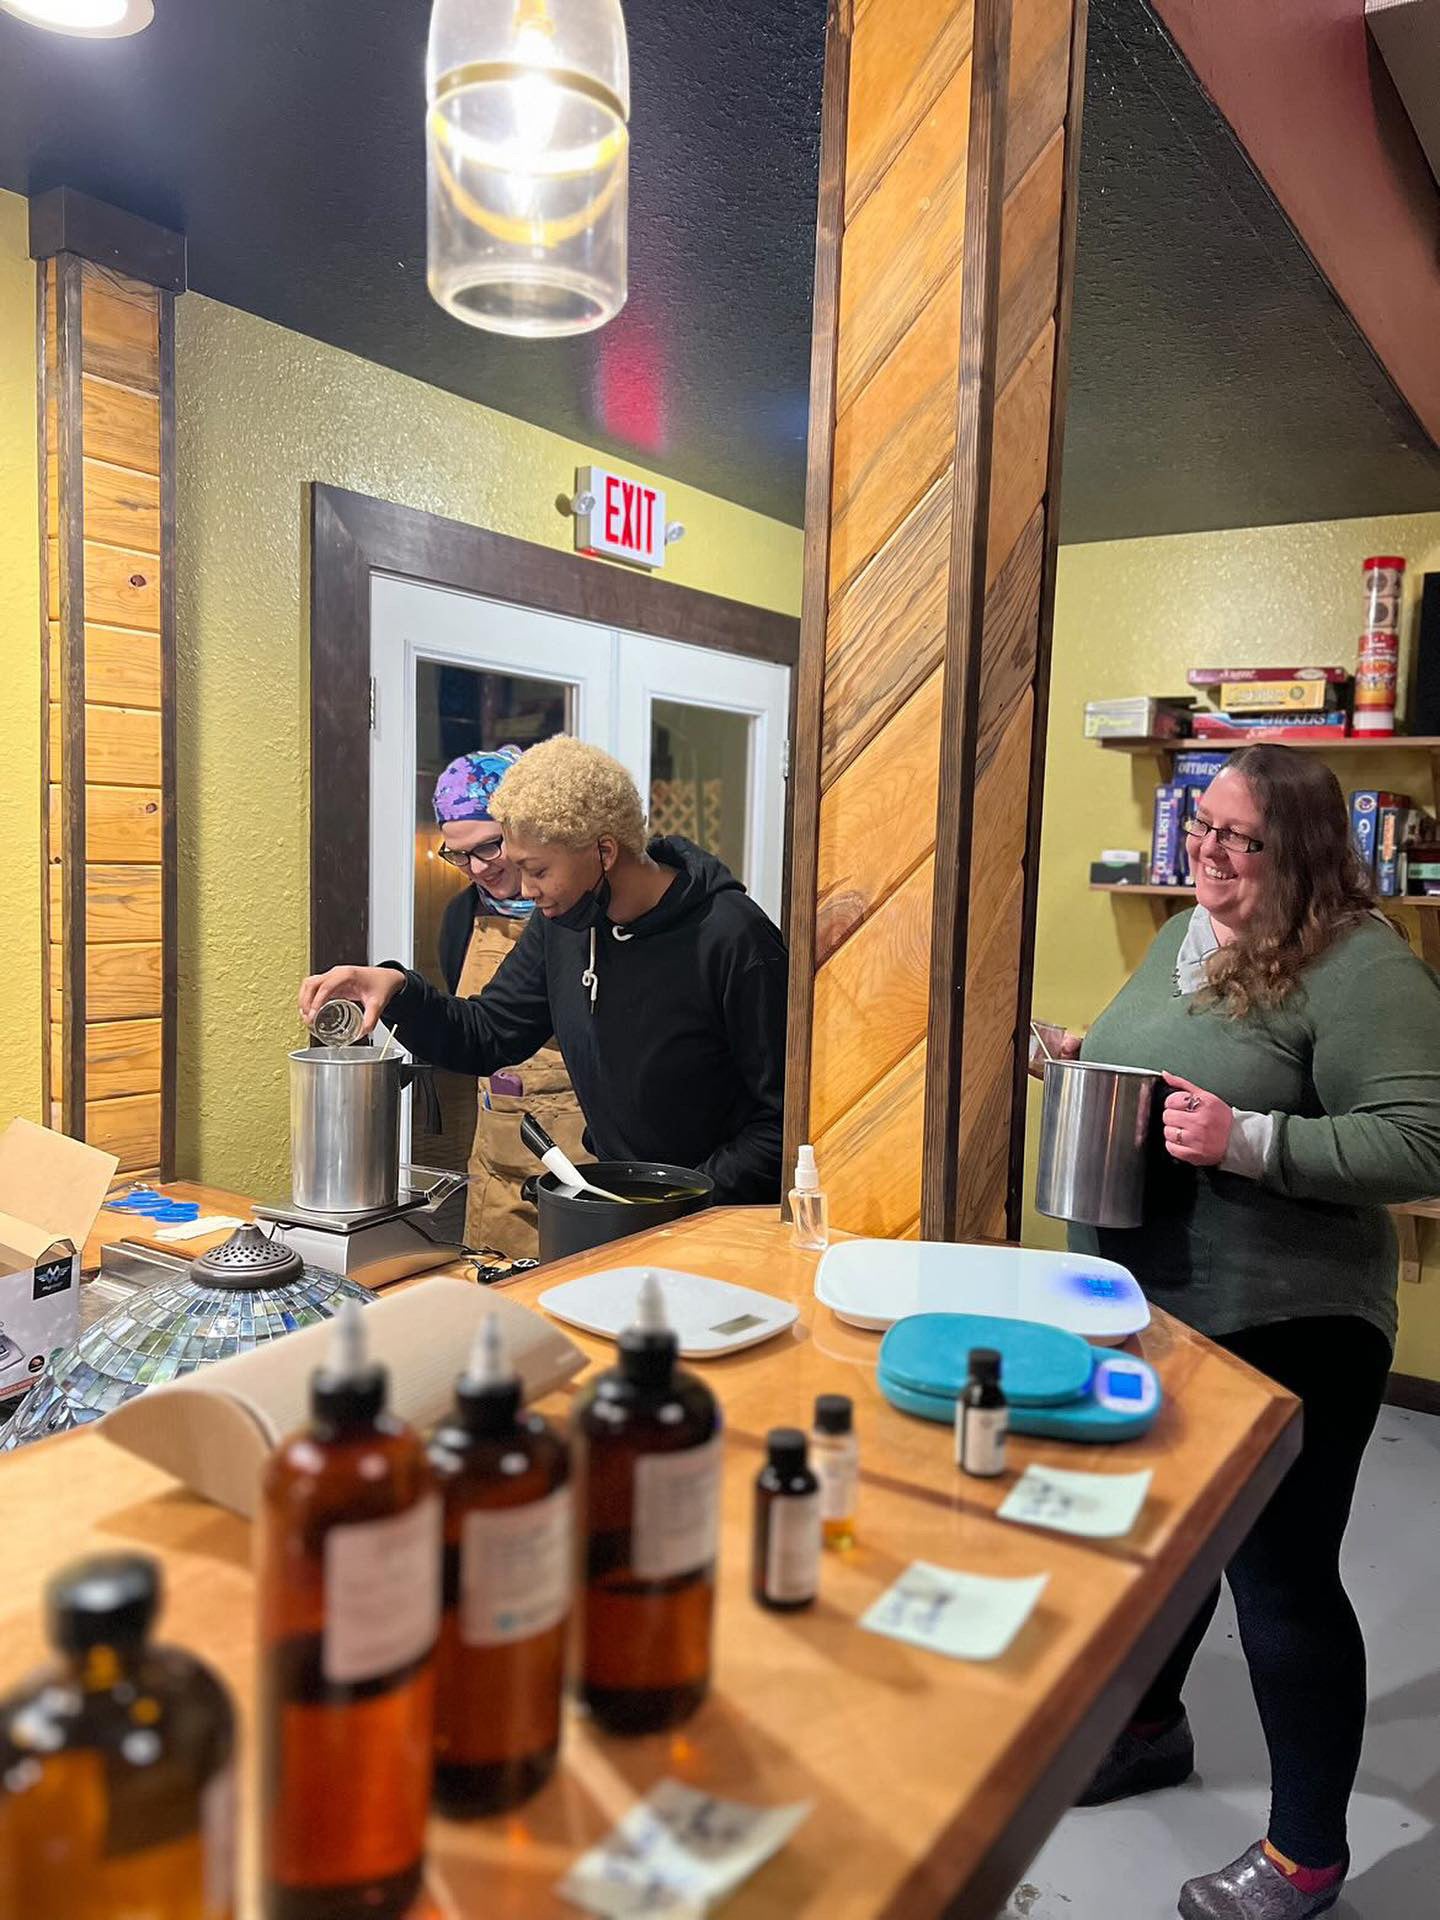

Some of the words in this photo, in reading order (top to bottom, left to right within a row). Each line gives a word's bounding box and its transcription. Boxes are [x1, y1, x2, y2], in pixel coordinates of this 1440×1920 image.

[605, 476, 656, 554] EXIT
[1259, 713, 1326, 725] CHECKERS
[1178, 761, 1221, 775] OUTBURS
[1156, 811, 1170, 873] OUTBURST
